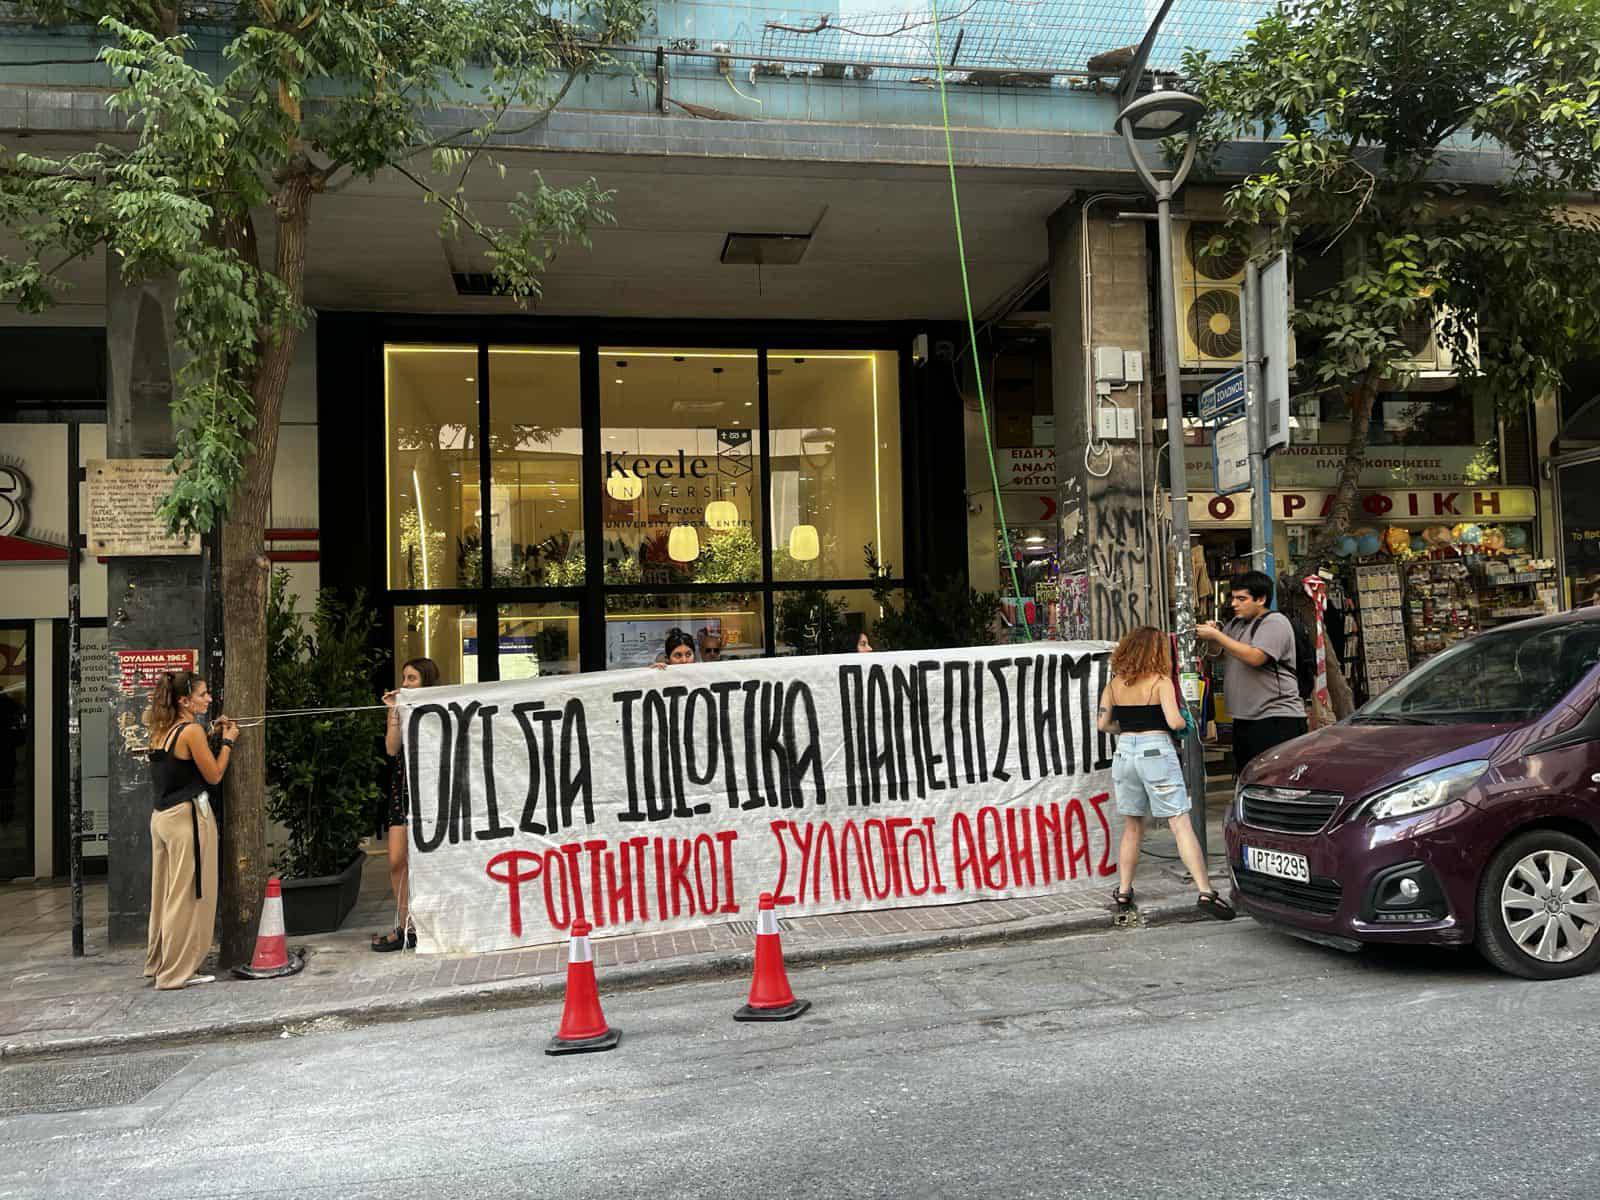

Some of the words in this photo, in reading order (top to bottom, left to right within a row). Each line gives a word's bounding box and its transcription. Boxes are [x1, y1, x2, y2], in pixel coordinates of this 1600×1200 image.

[604, 449, 709, 479] Keele
[1011, 449, 1043, 459] ΕΙΔΗ
[658, 504, 704, 516] Greece
[408, 701, 514, 853] ΟΧΙ
[511, 698, 595, 836] ΣΤΑ
[839, 652, 1115, 806] ΠΑΝΕΠΙΣΤΗΜΙ
[485, 830, 740, 938] ΦΟΙΤΗΤΙΚΟΙ
[769, 816, 946, 906] ΣΥΛΛΟΓΟΙ
[952, 792, 1117, 890] ΑΘΗΝΑΣ
